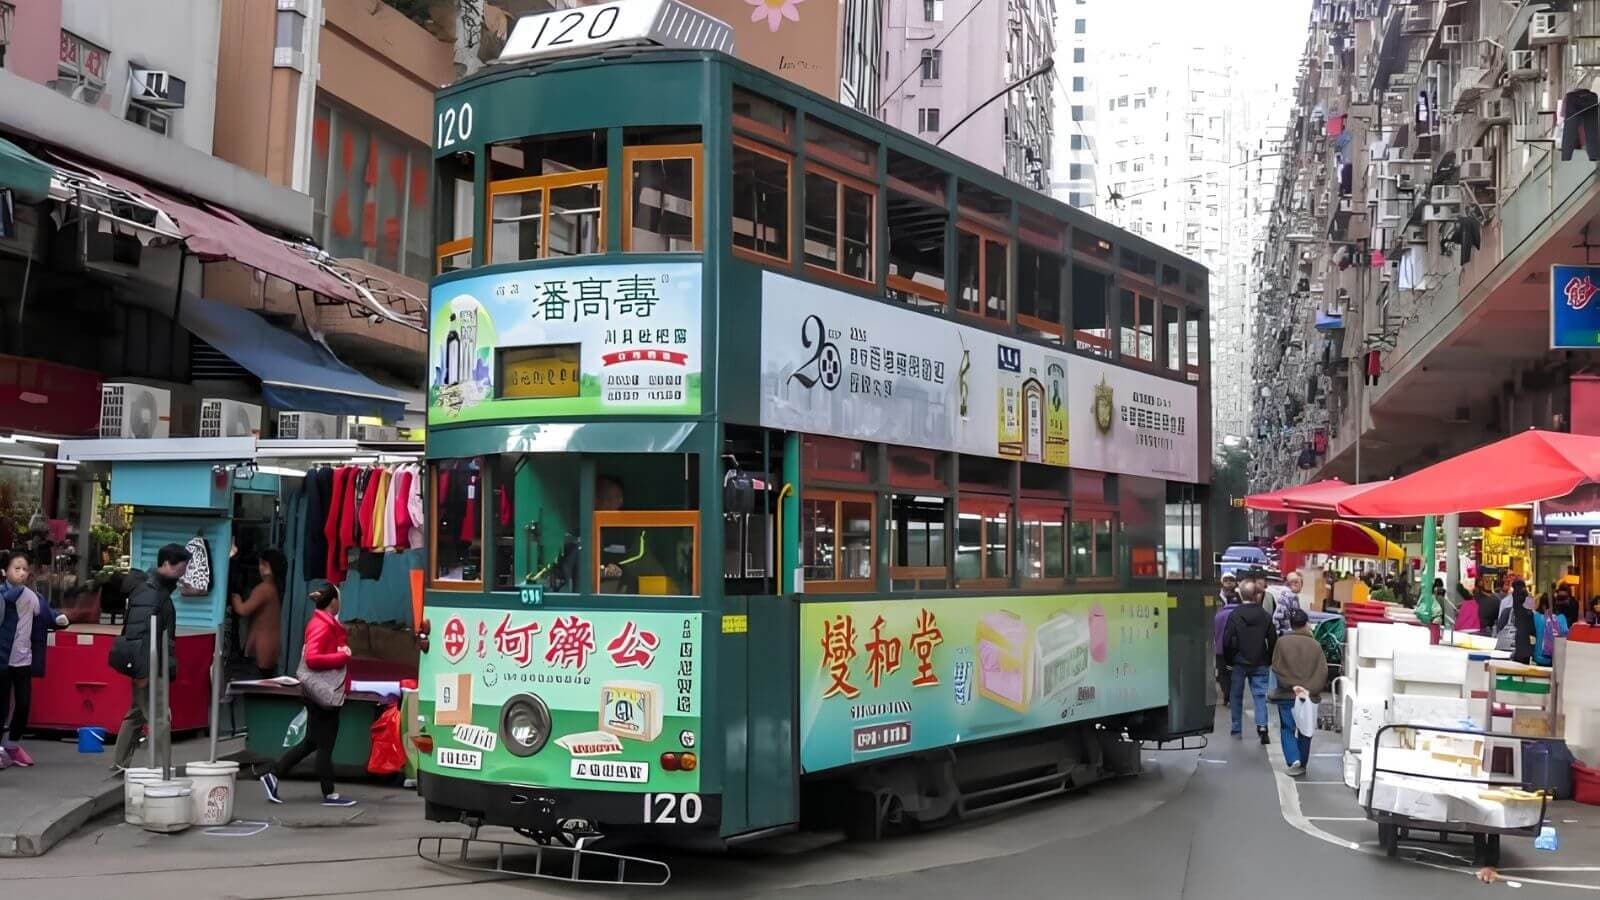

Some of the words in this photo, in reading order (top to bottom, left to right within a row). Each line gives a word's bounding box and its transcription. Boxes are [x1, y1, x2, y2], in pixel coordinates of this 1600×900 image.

[531, 6, 620, 49] 120
[437, 102, 473, 149] 120
[643, 792, 703, 824] 120
